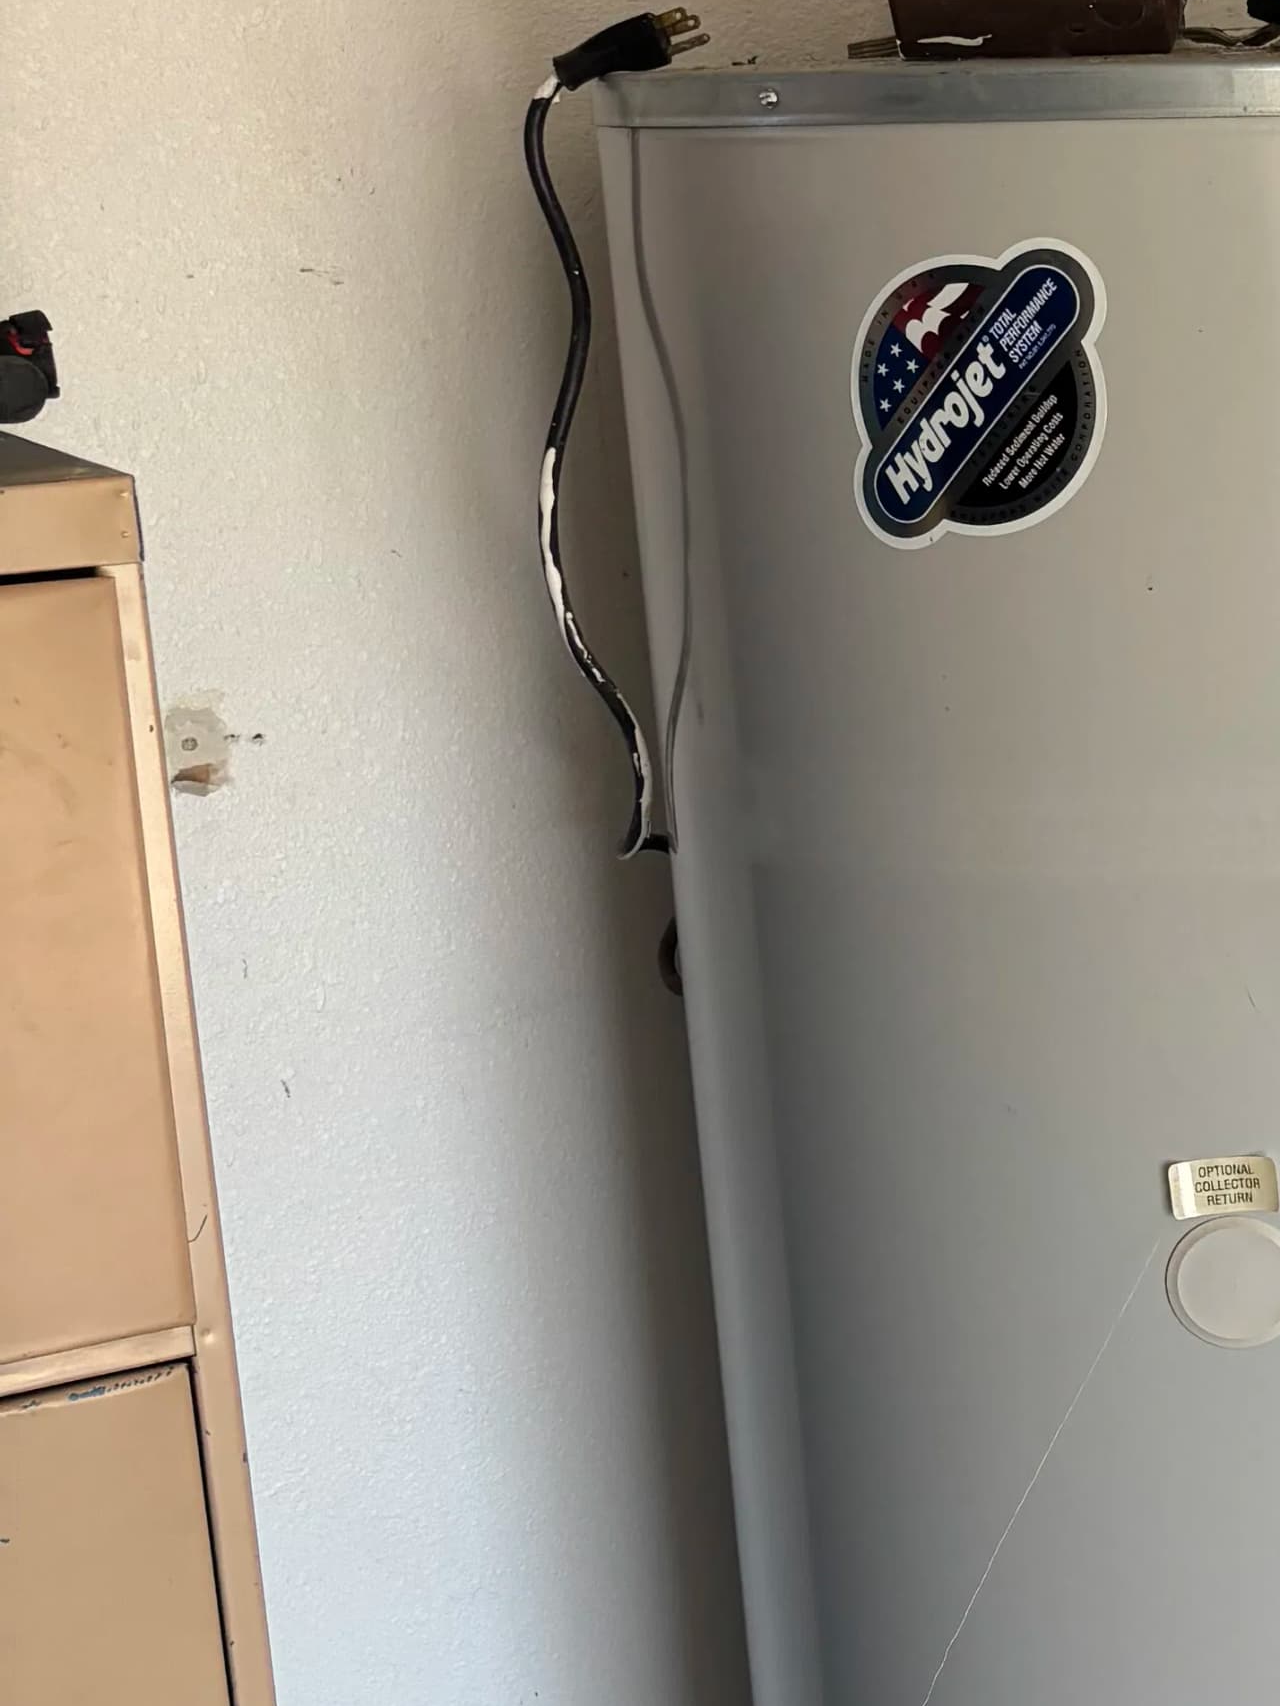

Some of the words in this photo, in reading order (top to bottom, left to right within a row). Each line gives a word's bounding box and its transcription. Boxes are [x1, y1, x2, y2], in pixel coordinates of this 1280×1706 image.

[989, 307, 1015, 339] TOTAL
[998, 277, 1057, 352] PERFORMANCE
[1008, 320, 1044, 364] SYSTEM
[885, 341, 1006, 504] Hydrojet
[1042, 410, 1062, 435] Costs
[1018, 466, 1037, 489] More
[1033, 453, 1048, 470] Hot
[1044, 431, 1065, 456] Water
[1195, 1178, 1260, 1193] COLLECTOR
[1198, 1164, 1254, 1178] OPTIONAL
[1207, 1192, 1253, 1206] RETURN
